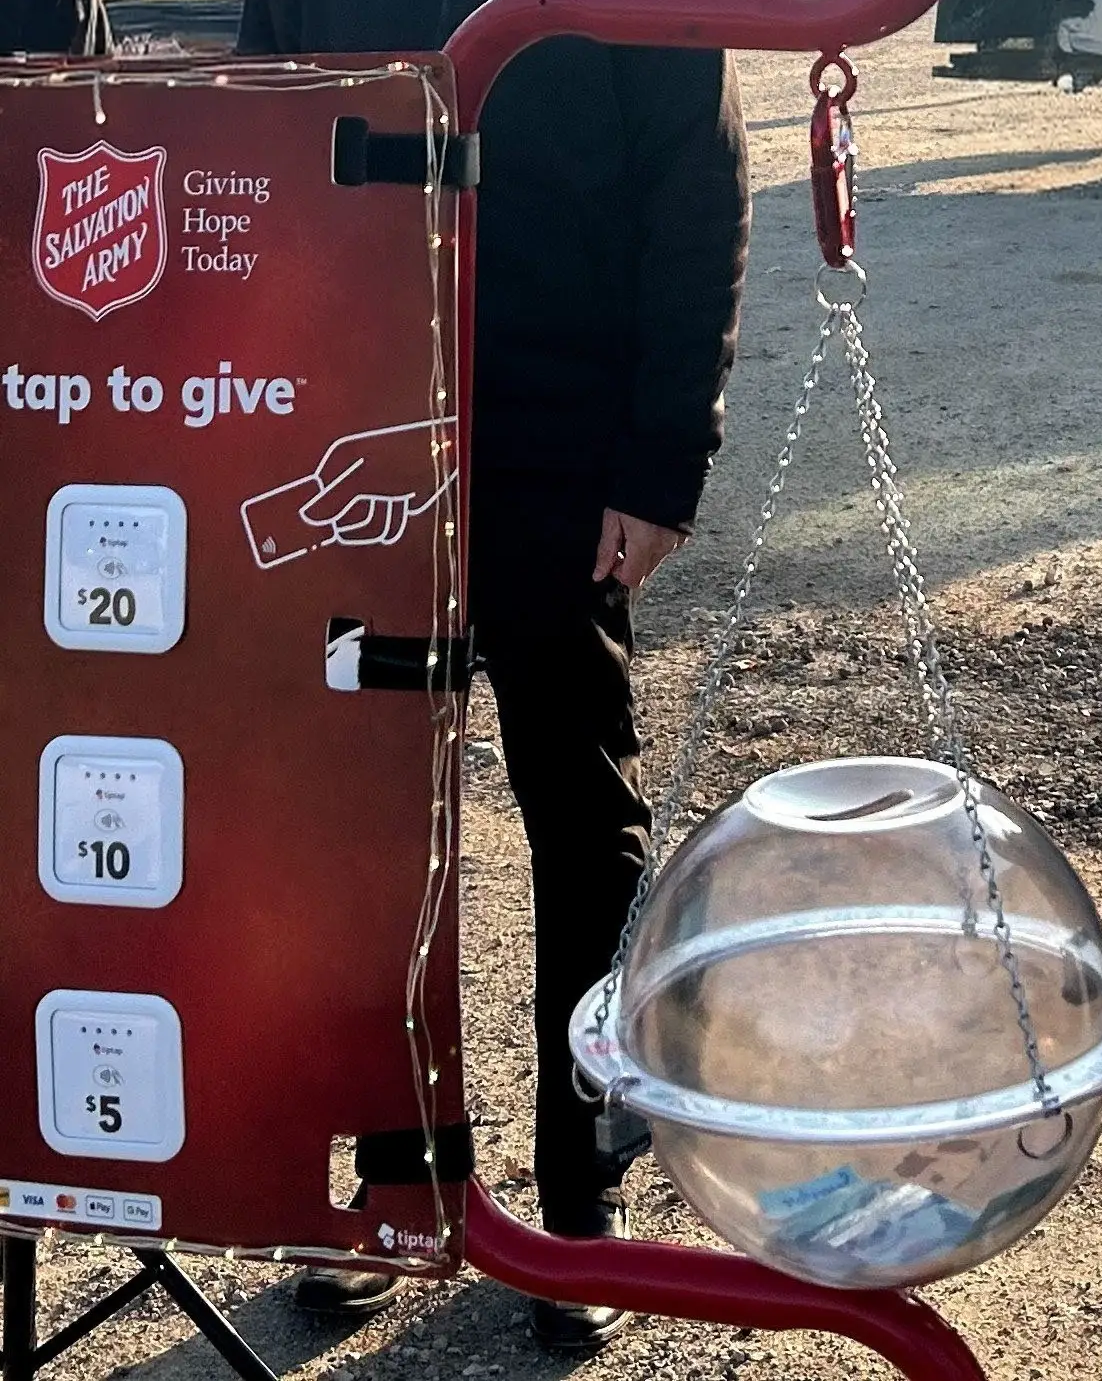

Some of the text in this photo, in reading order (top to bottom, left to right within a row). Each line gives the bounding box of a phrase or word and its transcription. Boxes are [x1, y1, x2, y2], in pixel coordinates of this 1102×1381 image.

[62, 164, 111, 216] THE
[183, 170, 271, 204] Giving
[45, 175, 150, 269] SALVATION
[182, 207, 252, 242] Hope
[81, 222, 148, 293] ARMY
[181, 245, 259, 280] Today
[2, 363, 92, 424] tap
[107, 365, 164, 413] to
[77, 586, 136, 626] $20
[78, 841, 130, 880] $10
[85, 1094, 122, 1133] $5
[22, 1194, 45, 1206] VISA
[96, 1202, 111, 1213] Pay
[136, 1207, 149, 1218] Pay
[397, 1230, 444, 1255] tiptap
